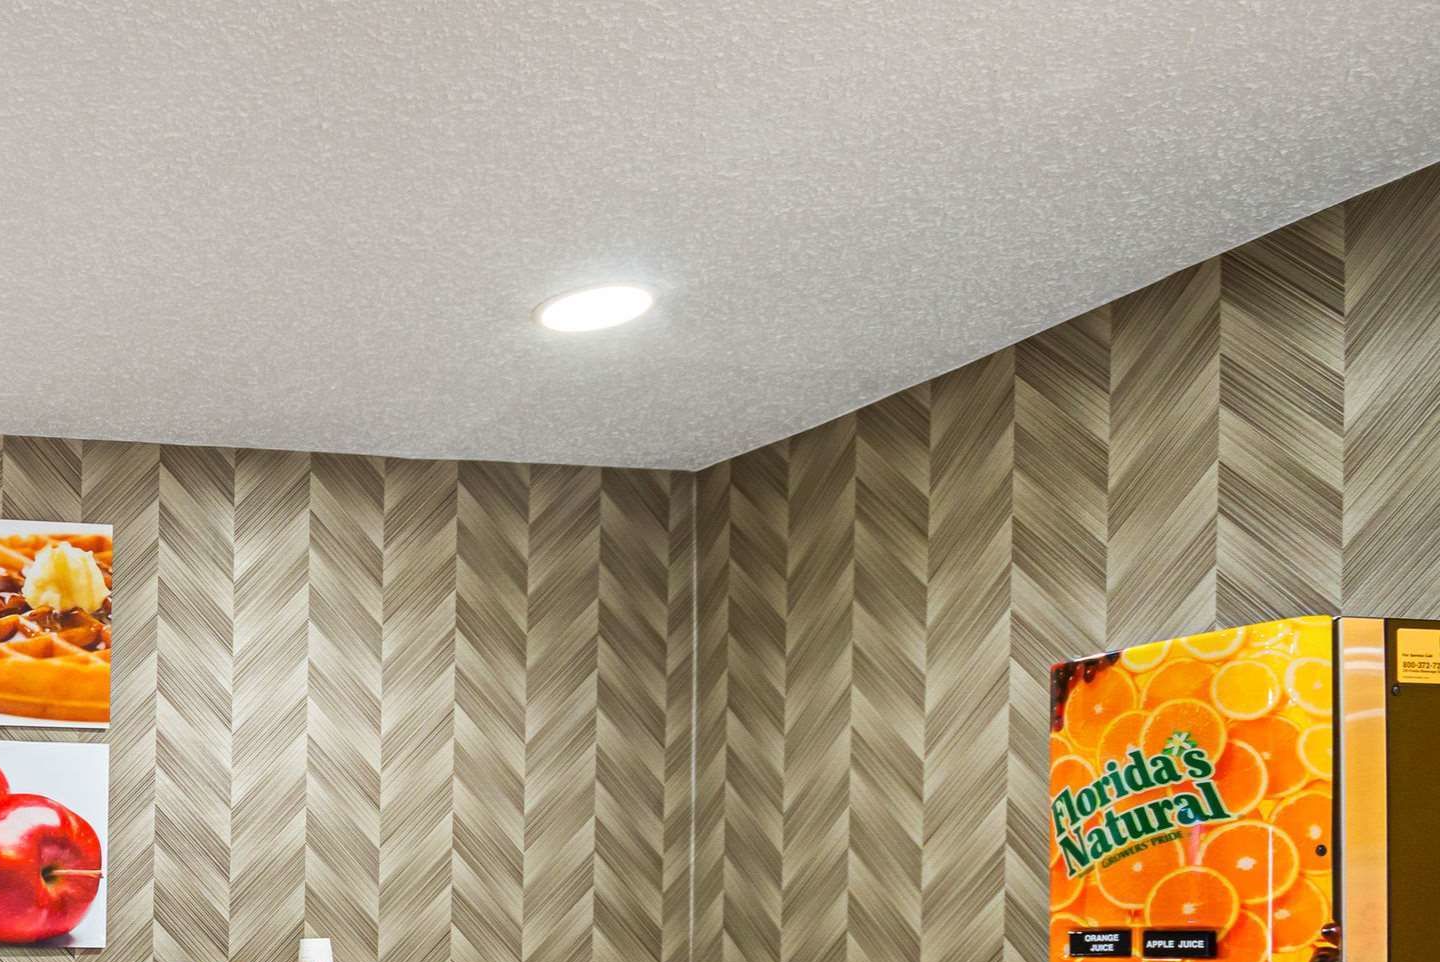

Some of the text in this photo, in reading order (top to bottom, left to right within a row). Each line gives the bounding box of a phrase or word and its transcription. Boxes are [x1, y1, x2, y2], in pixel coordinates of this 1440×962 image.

[1051, 748, 1213, 837] Florida's
[1058, 781, 1232, 877] Natural
[1084, 933, 1120, 942] ORANGE
[1089, 943, 1115, 952] JUICE
[1146, 940, 1205, 949] APPLE JUICE
